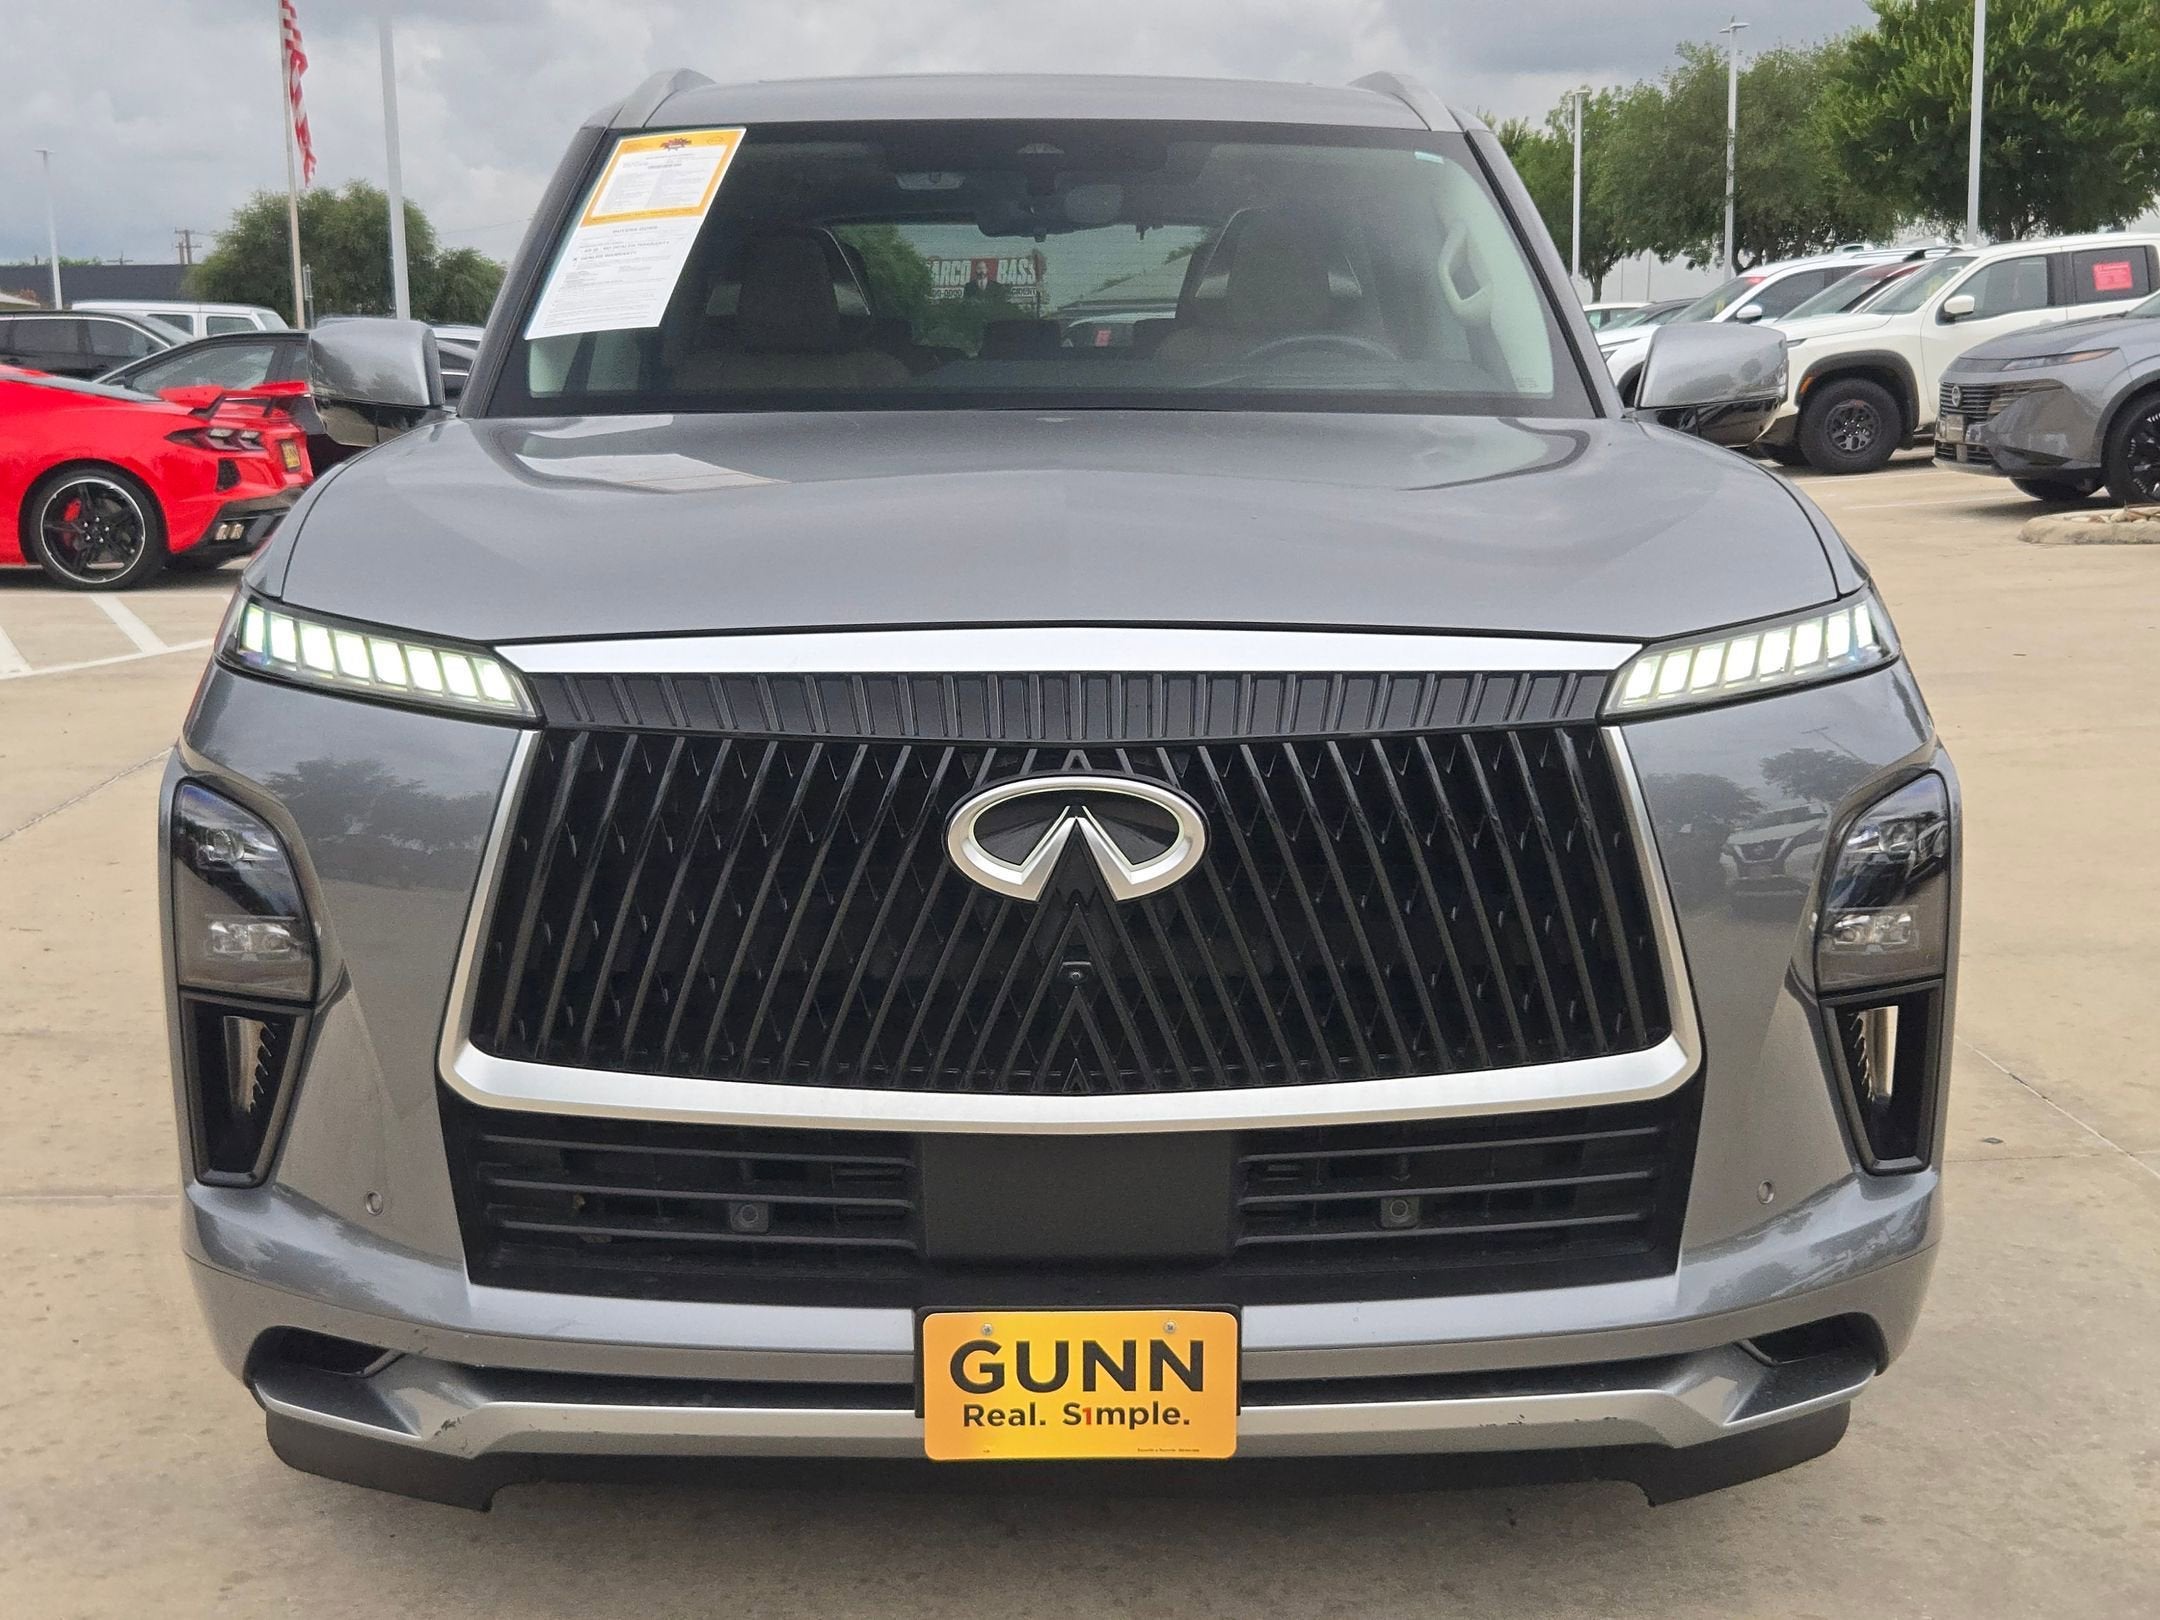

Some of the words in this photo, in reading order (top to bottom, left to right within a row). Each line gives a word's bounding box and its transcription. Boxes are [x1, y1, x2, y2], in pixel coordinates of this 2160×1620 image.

[927, 259, 972, 286] ARCO
[950, 1338, 1204, 1394] GUNN
[963, 1401, 1047, 1427] Real.
